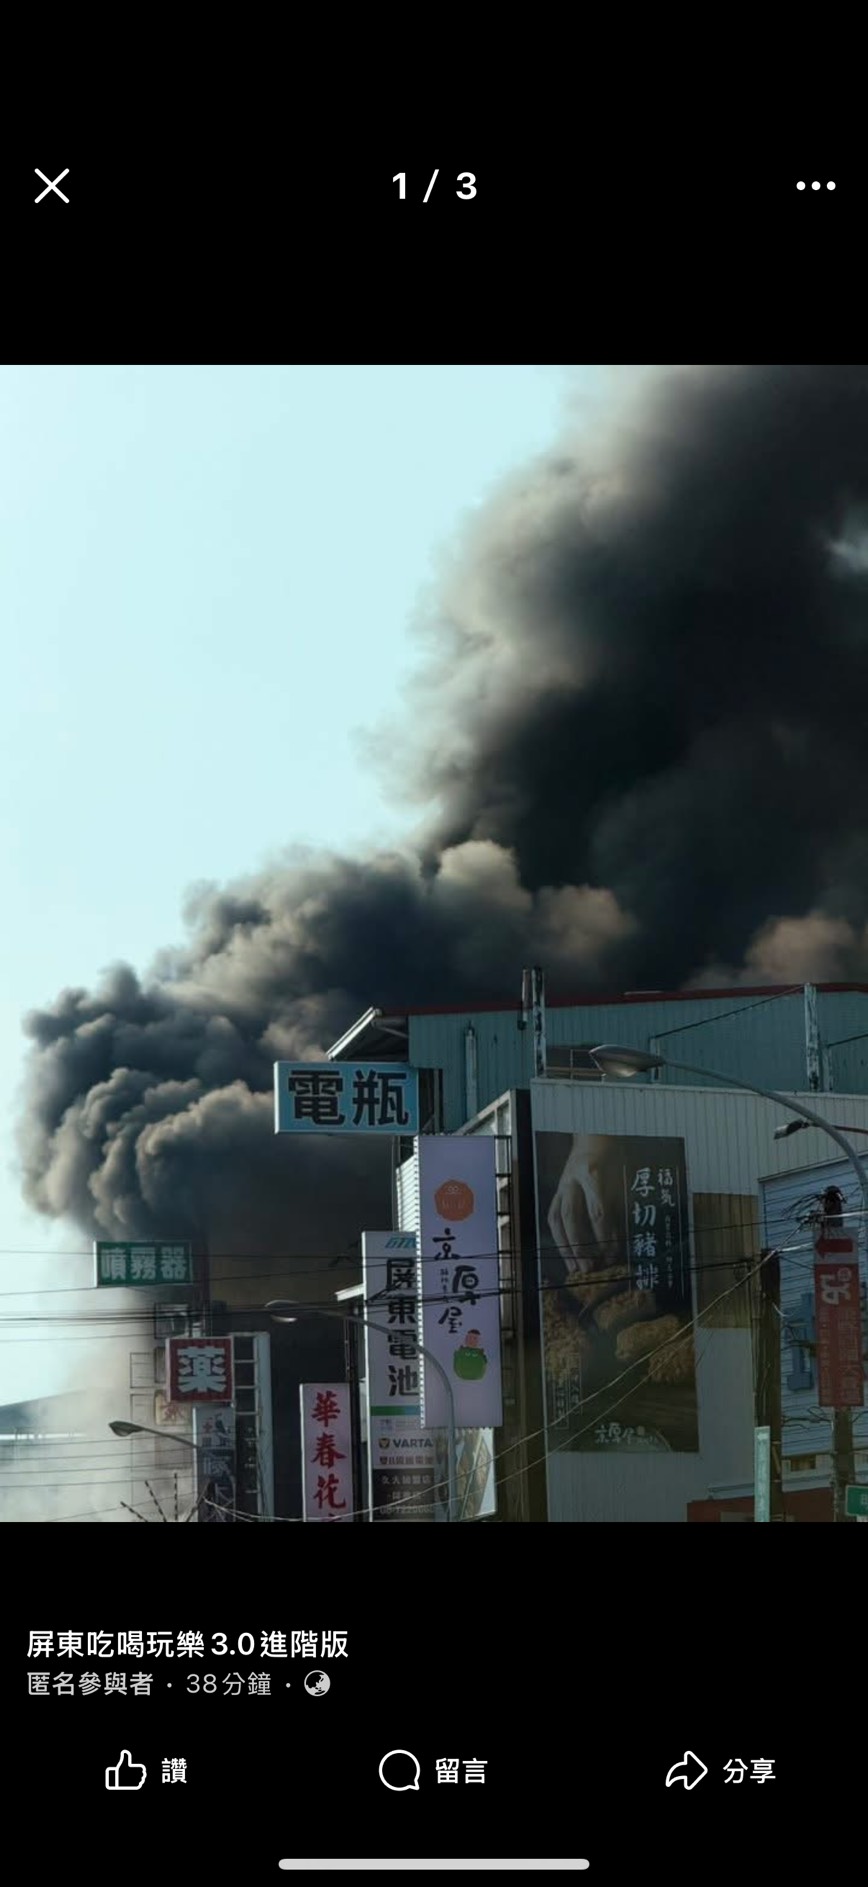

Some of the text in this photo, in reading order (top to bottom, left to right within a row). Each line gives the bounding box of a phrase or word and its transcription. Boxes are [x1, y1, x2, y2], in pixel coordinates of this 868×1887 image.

[288, 1069, 409, 1127] 電瓶
[101, 1247, 187, 1280] 噴霧器
[631, 1167, 659, 1291] 厚切豬排
[387, 1258, 420, 1397] 屏東電池
[311, 1390, 347, 1523] 華春花
[393, 1438, 434, 1448] VARTA
